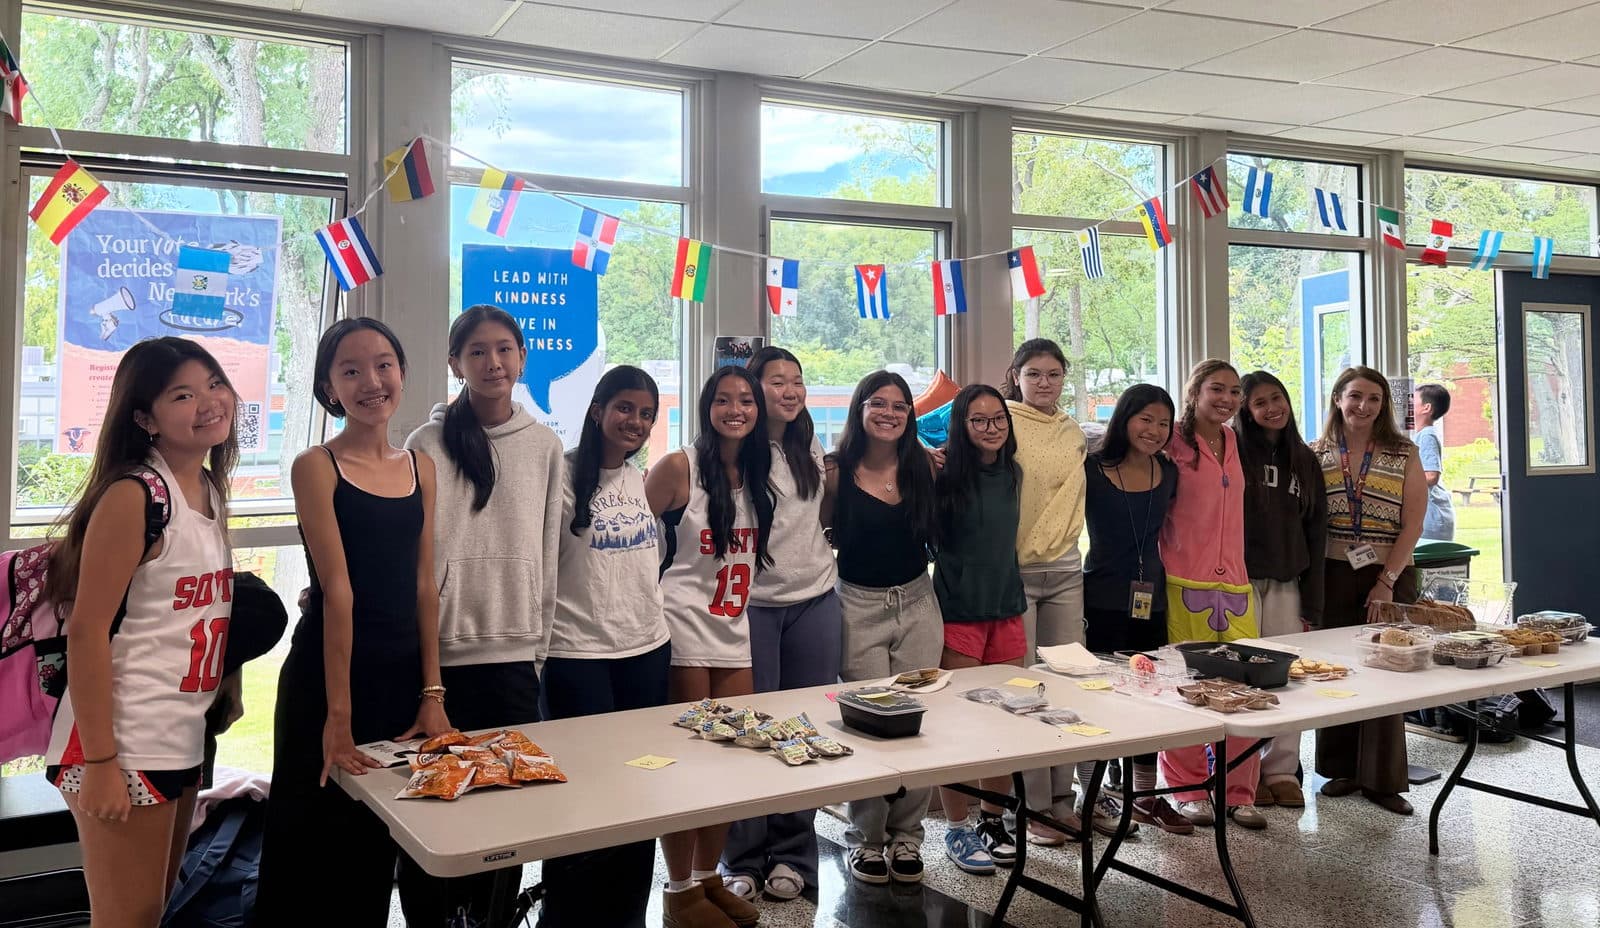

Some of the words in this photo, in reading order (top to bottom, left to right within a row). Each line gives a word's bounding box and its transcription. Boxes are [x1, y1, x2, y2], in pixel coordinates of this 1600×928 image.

[96, 234, 149, 255] Your
[97, 258, 173, 278] decides
[493, 270, 531, 284] LEAD
[537, 272, 568, 285] WITH
[148, 281, 178, 302] Ne
[225, 287, 260, 307] rk's
[495, 291, 566, 305] KINDNESS
[514, 317, 536, 330] VE
[543, 317, 556, 331] IN
[528, 338, 573, 351] TNESS
[708, 563, 750, 617] 13
[179, 617, 230, 693] 10
